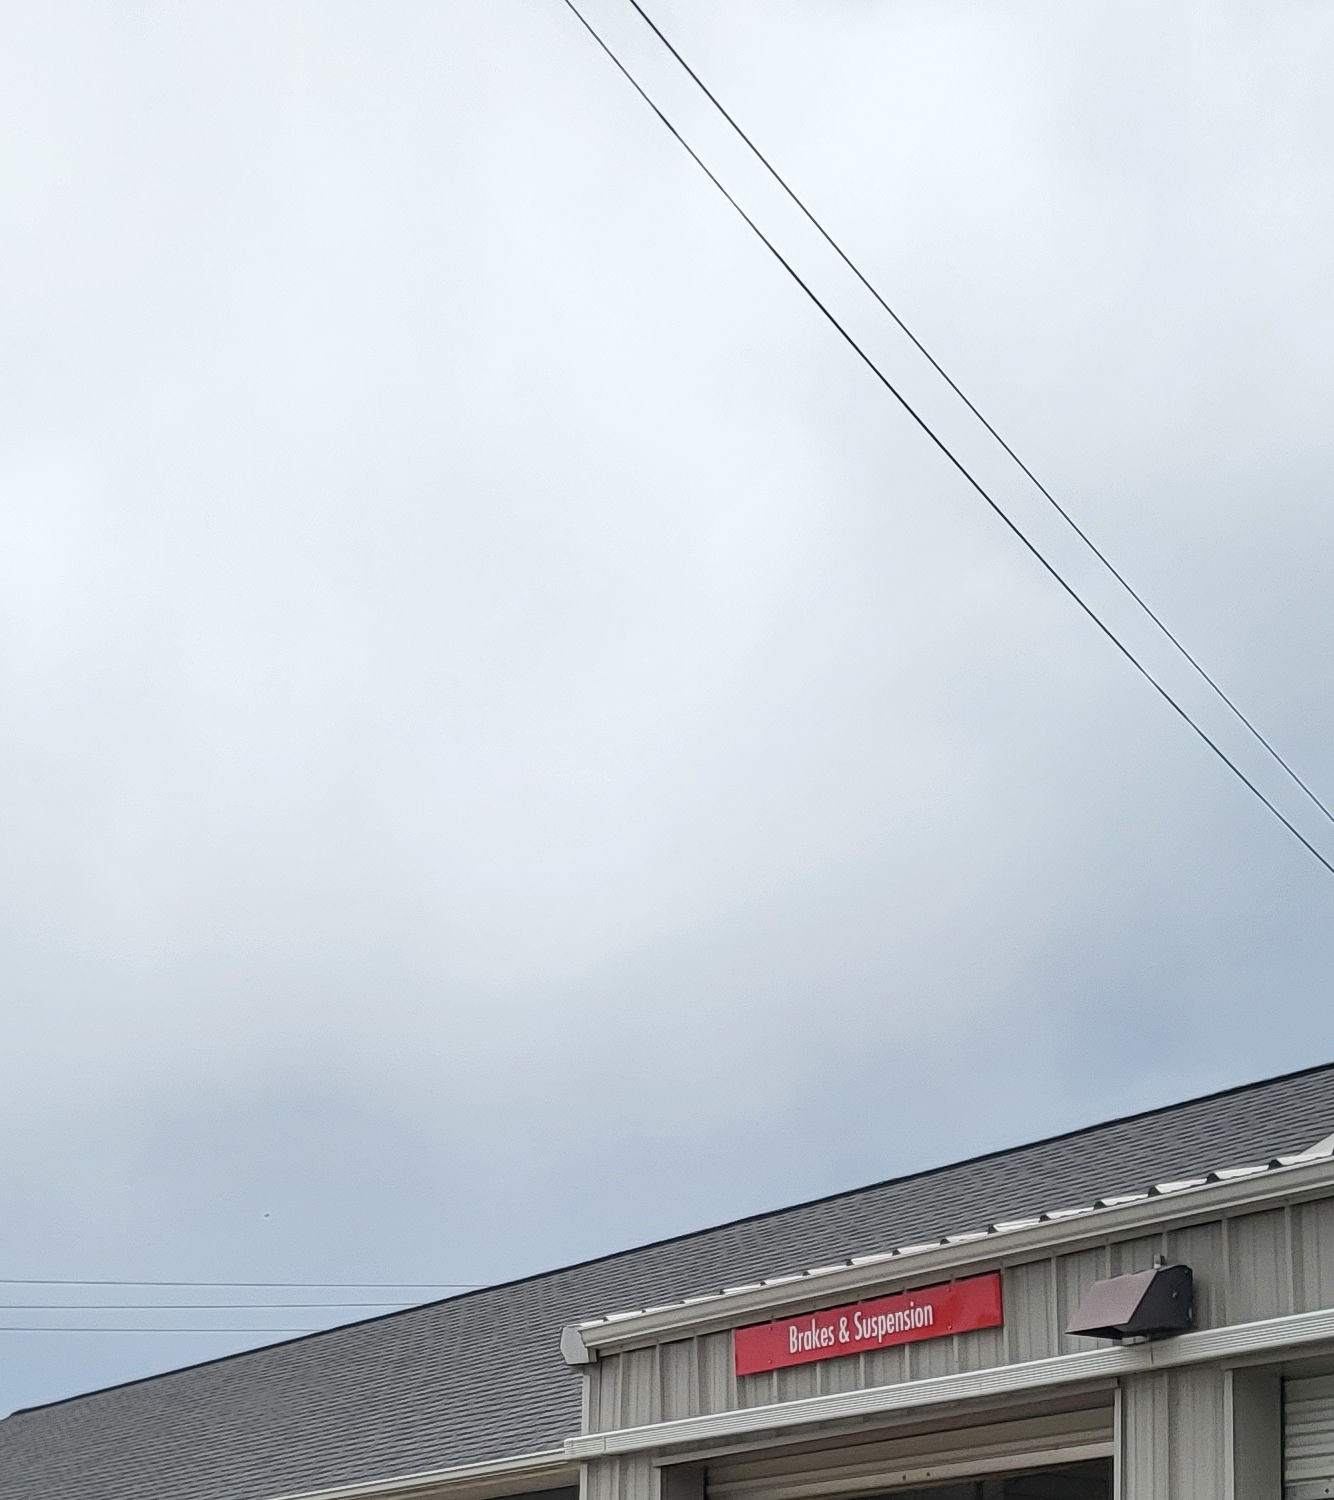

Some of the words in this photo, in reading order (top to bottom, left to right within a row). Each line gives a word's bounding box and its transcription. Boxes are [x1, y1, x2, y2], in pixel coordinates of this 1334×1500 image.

[788, 1318, 835, 1354] Brakes
[839, 1316, 850, 1344] &
[854, 1301, 934, 1343] Suspension
